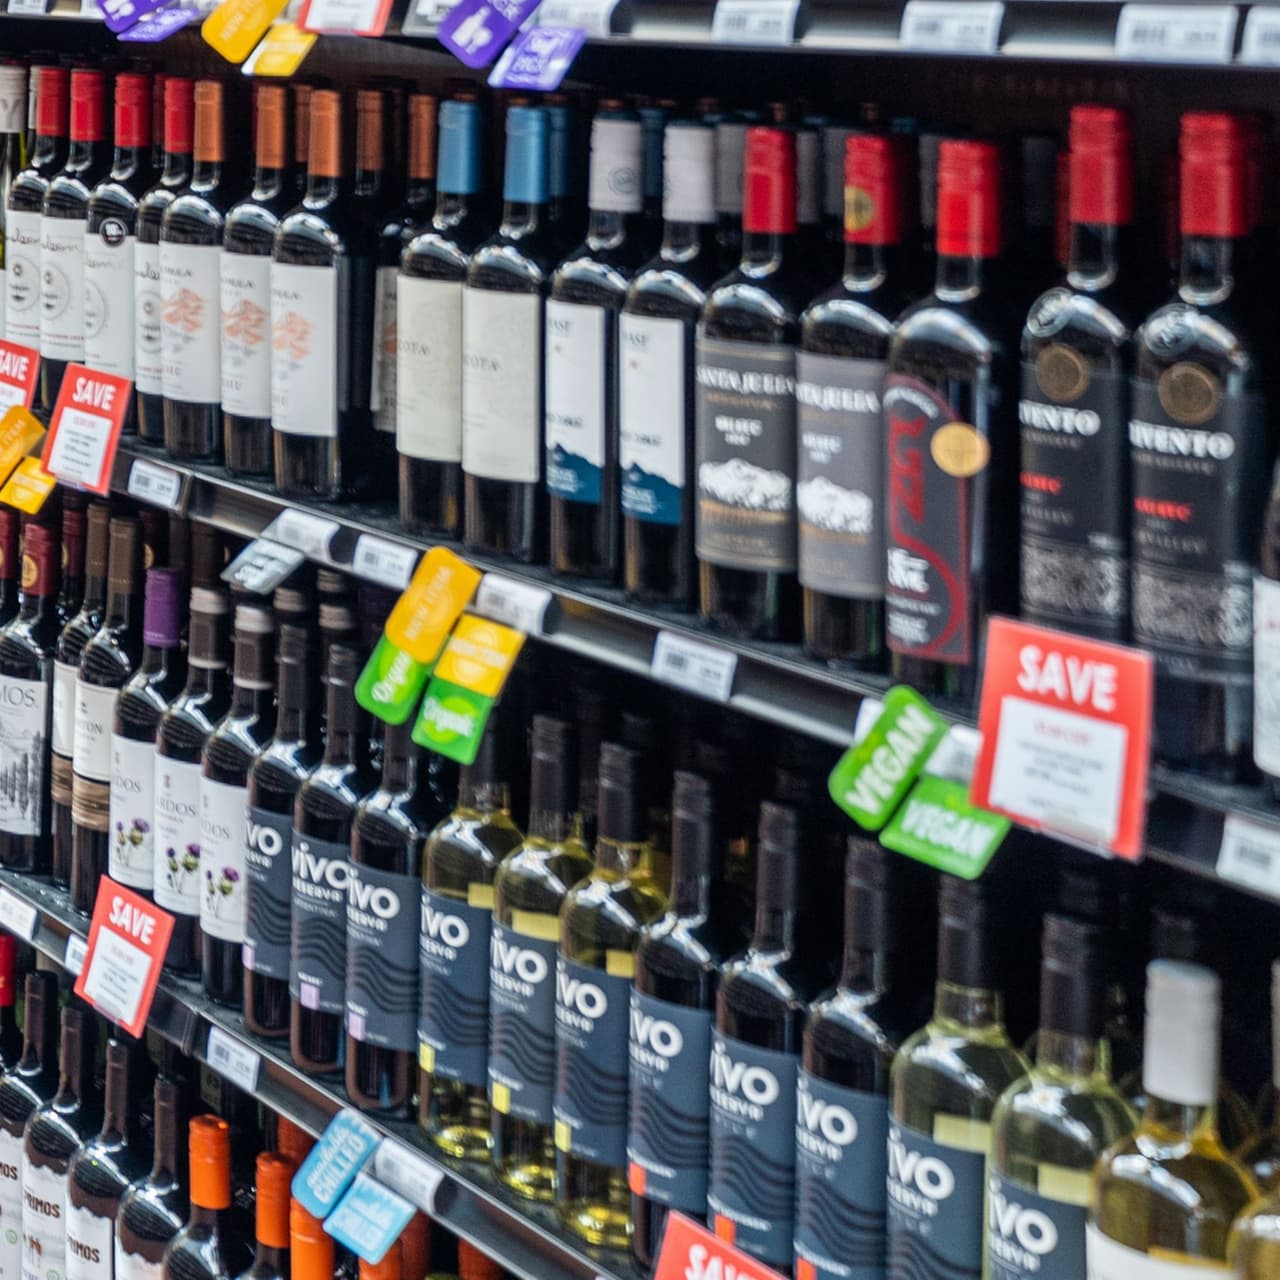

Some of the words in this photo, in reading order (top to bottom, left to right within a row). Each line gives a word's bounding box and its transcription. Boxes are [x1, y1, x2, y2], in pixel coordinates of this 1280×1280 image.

[71, 376, 117, 410] SAVE
[1018, 643, 1119, 714] SAVE
[846, 703, 935, 816] VEGAN
[899, 799, 996, 857] VEGAN
[110, 895, 158, 946] SAVE
[312, 1132, 367, 1205] CHILLED
[685, 1243, 758, 1280] SAV
